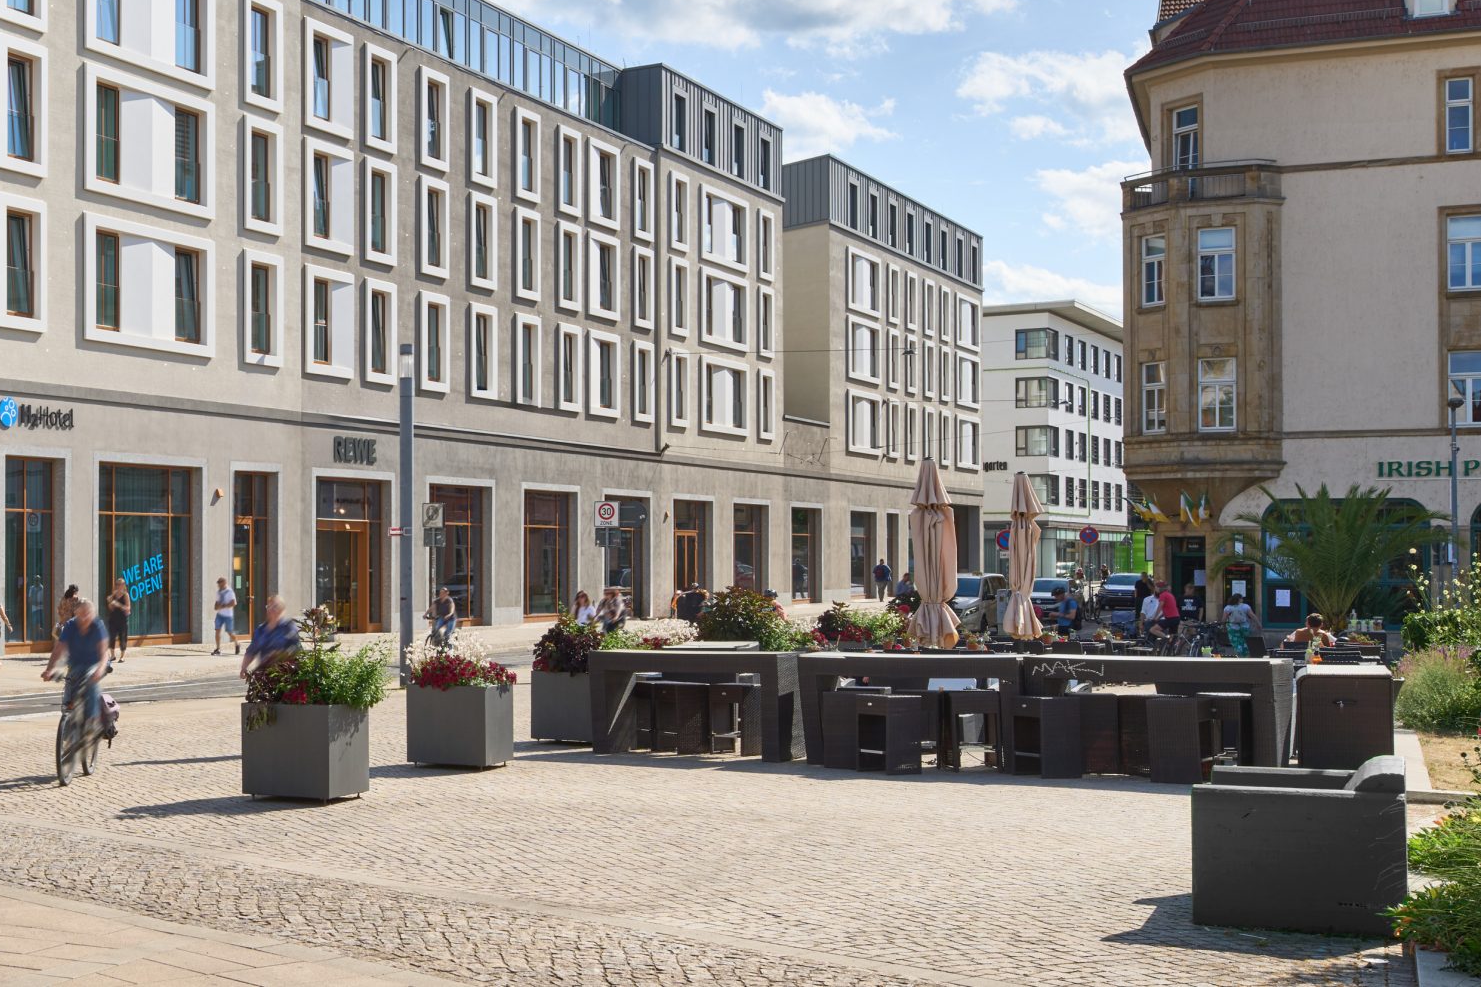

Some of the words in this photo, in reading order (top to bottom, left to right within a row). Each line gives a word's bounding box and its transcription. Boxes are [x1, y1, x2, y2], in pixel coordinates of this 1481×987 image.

[333, 436, 377, 465] REWE
[1377, 460, 1453, 477] IRISH
[601, 507, 612, 516] 30
[122, 564, 141, 585] WE
[143, 553, 164, 578] ARE
[130, 573, 163, 601] OPEN!
